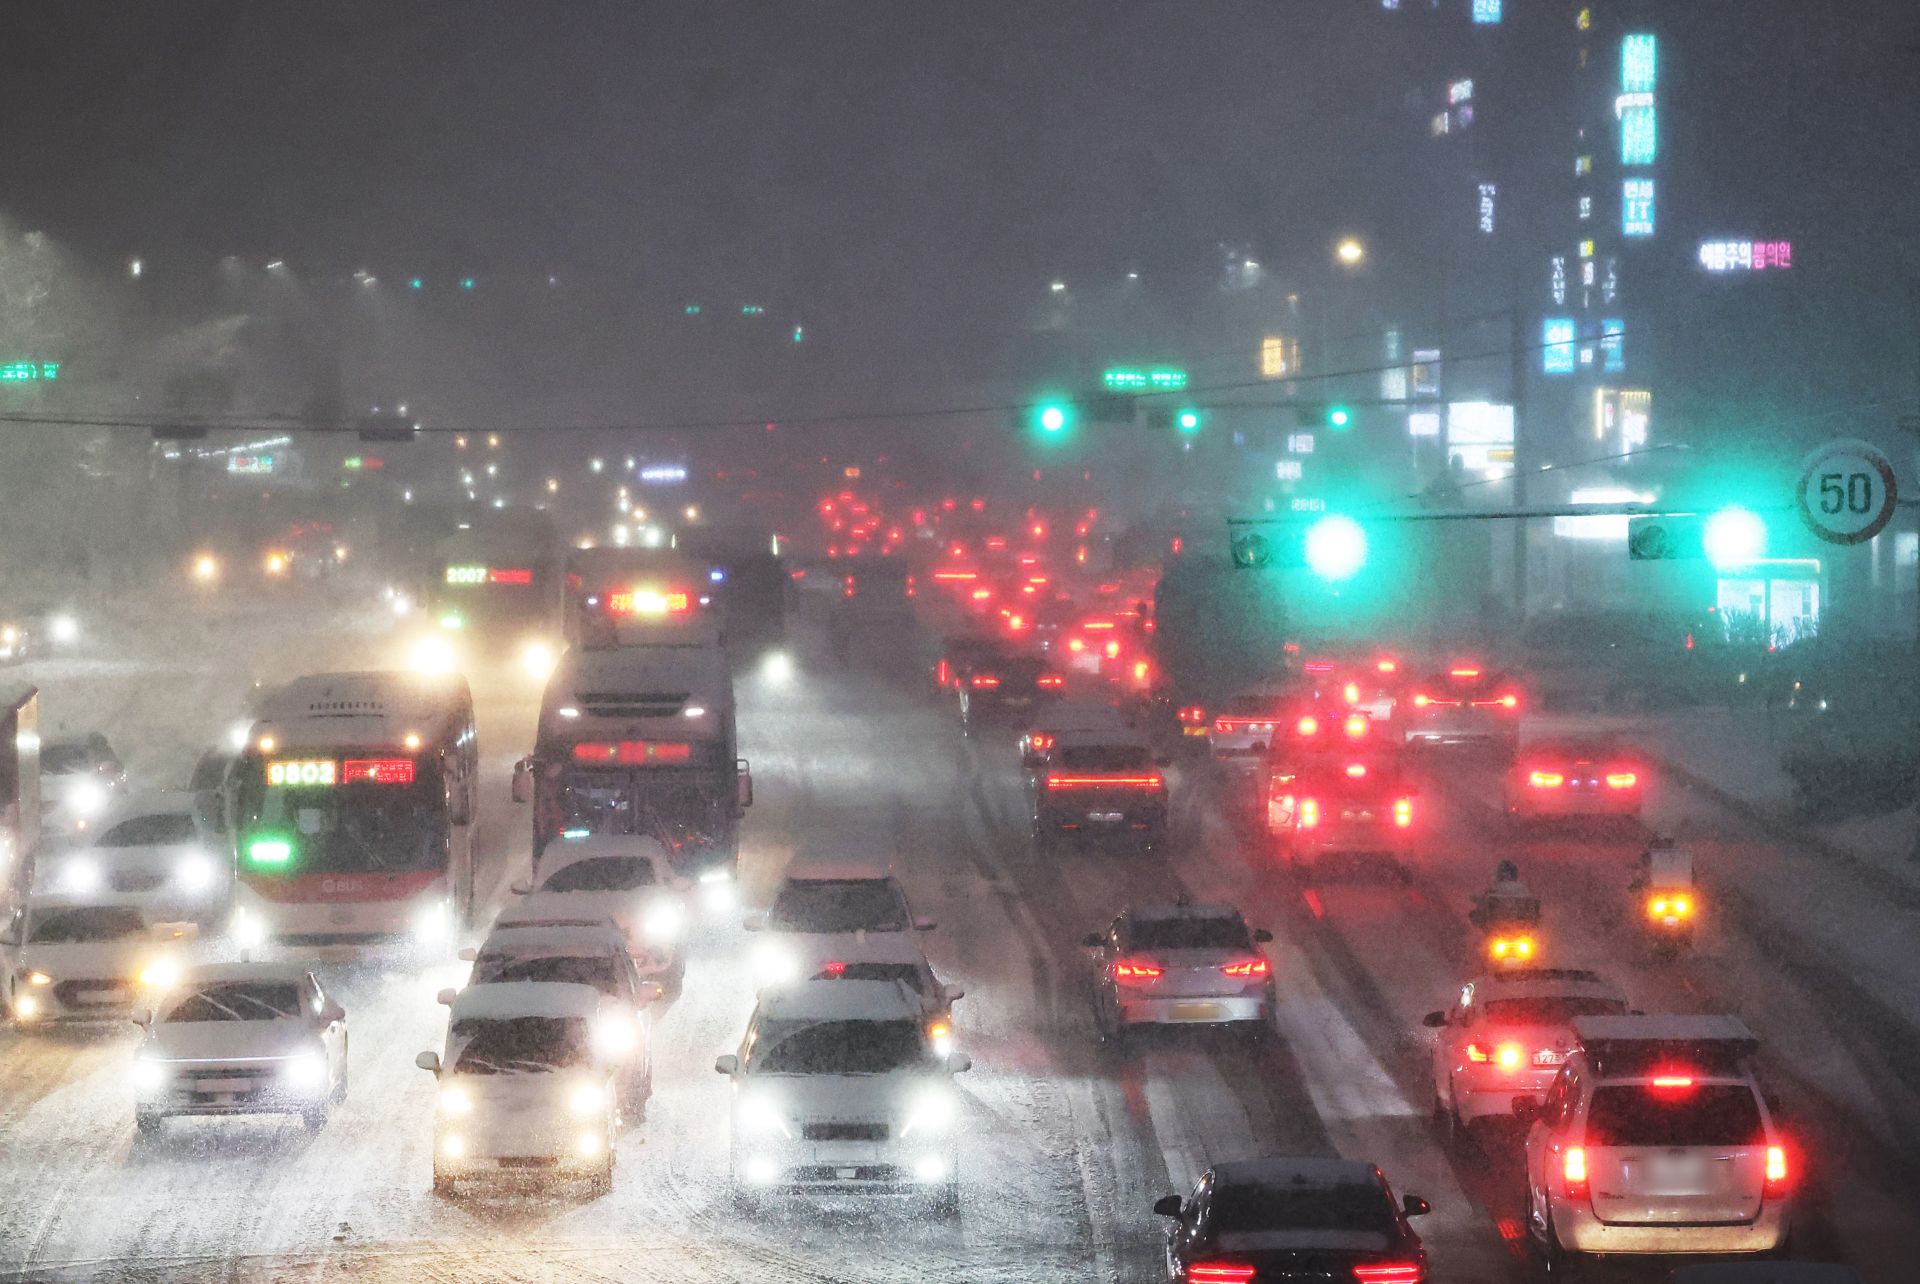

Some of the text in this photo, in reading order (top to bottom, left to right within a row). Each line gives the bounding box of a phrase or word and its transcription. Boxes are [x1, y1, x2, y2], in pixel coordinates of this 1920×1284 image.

[1820, 472, 1872, 514] 50
[447, 567, 486, 583] 2007
[269, 763, 334, 785] 9802
